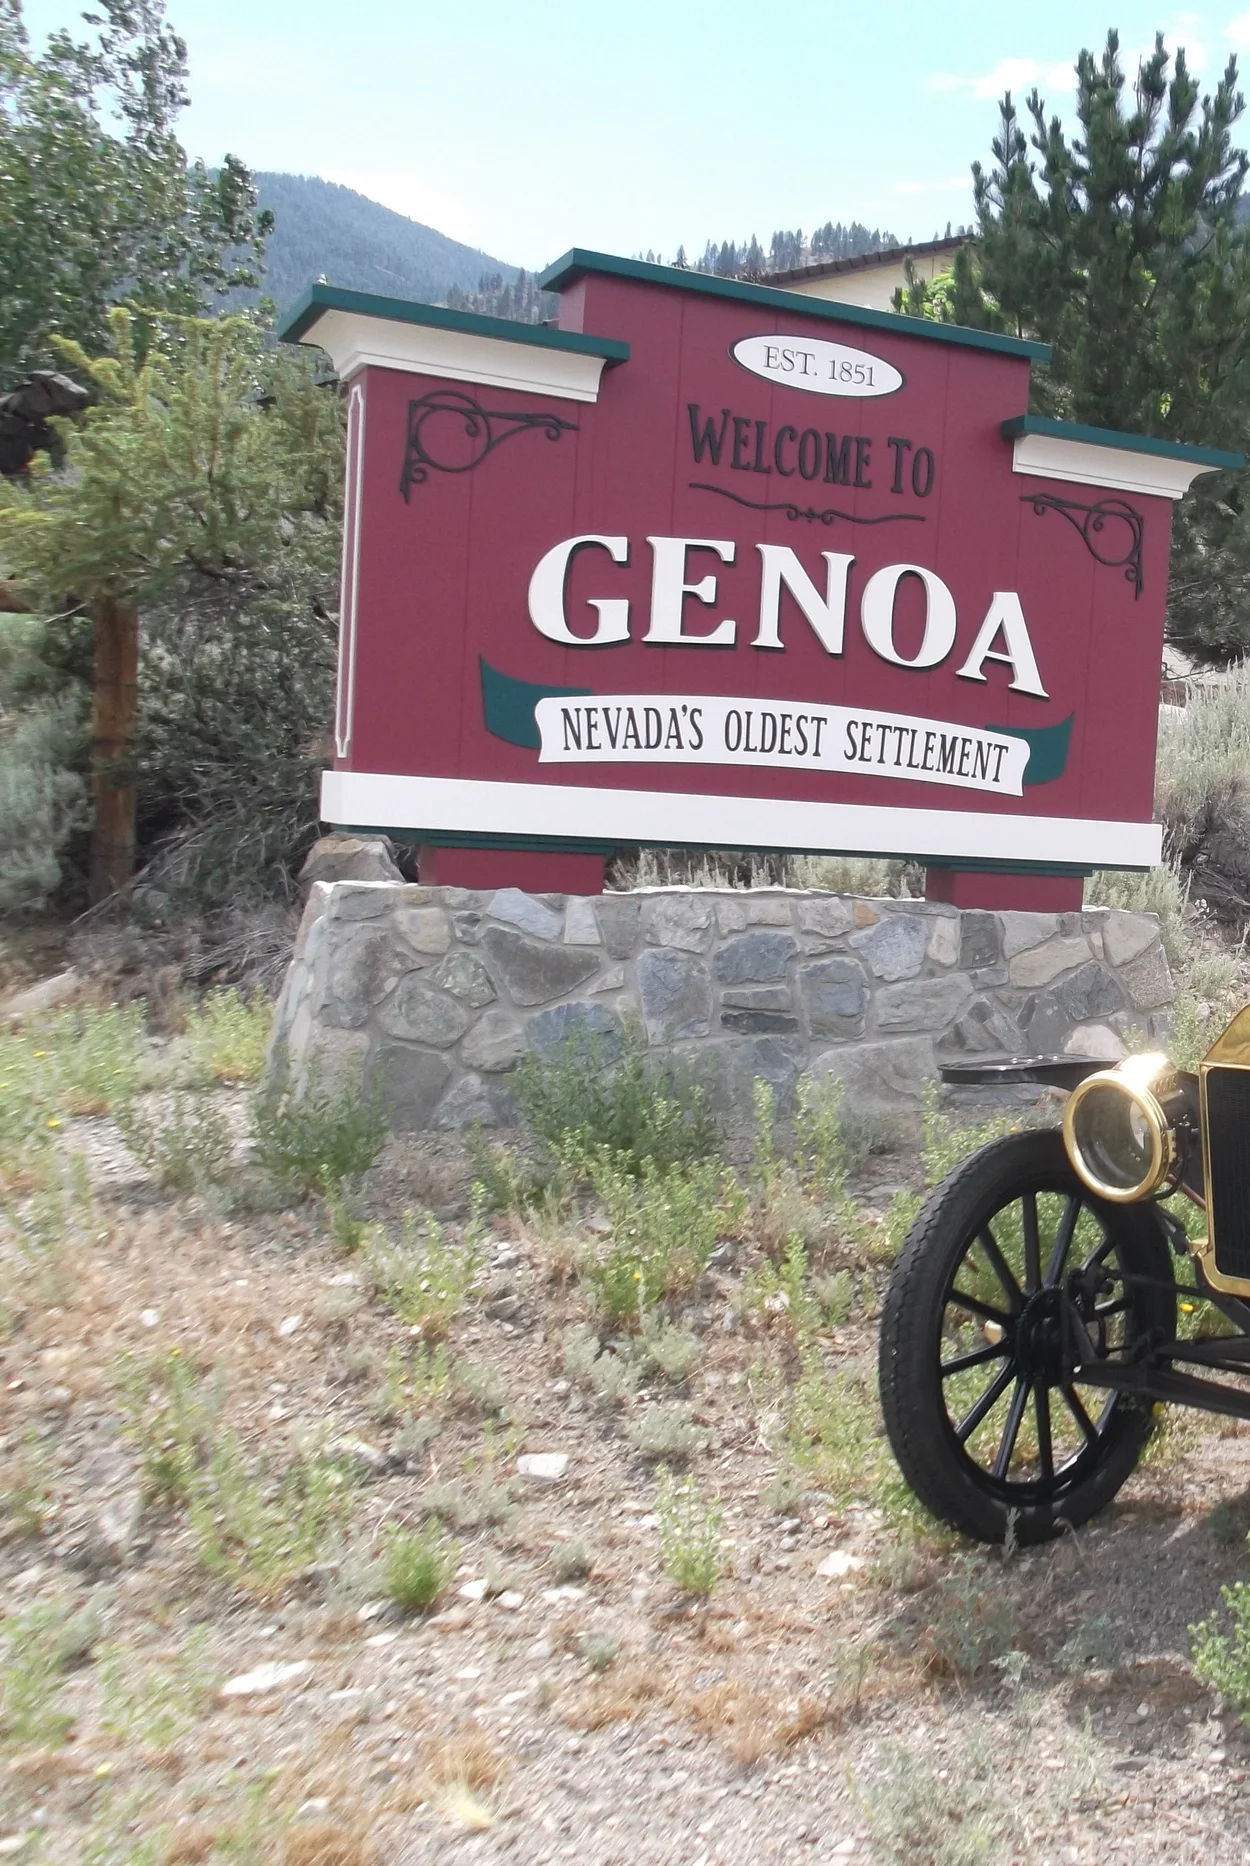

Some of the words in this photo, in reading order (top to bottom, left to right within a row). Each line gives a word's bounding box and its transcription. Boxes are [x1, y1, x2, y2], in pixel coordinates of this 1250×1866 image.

[763, 344, 818, 376] EST.
[828, 360, 876, 387] 1851
[687, 403, 873, 489] WELCOME
[887, 436, 936, 498] TO
[528, 534, 1050, 698] GENOA
[560, 704, 704, 751] NEVADA'S
[724, 709, 828, 758] OLDEST
[843, 719, 1010, 783] SETTLEMENT
